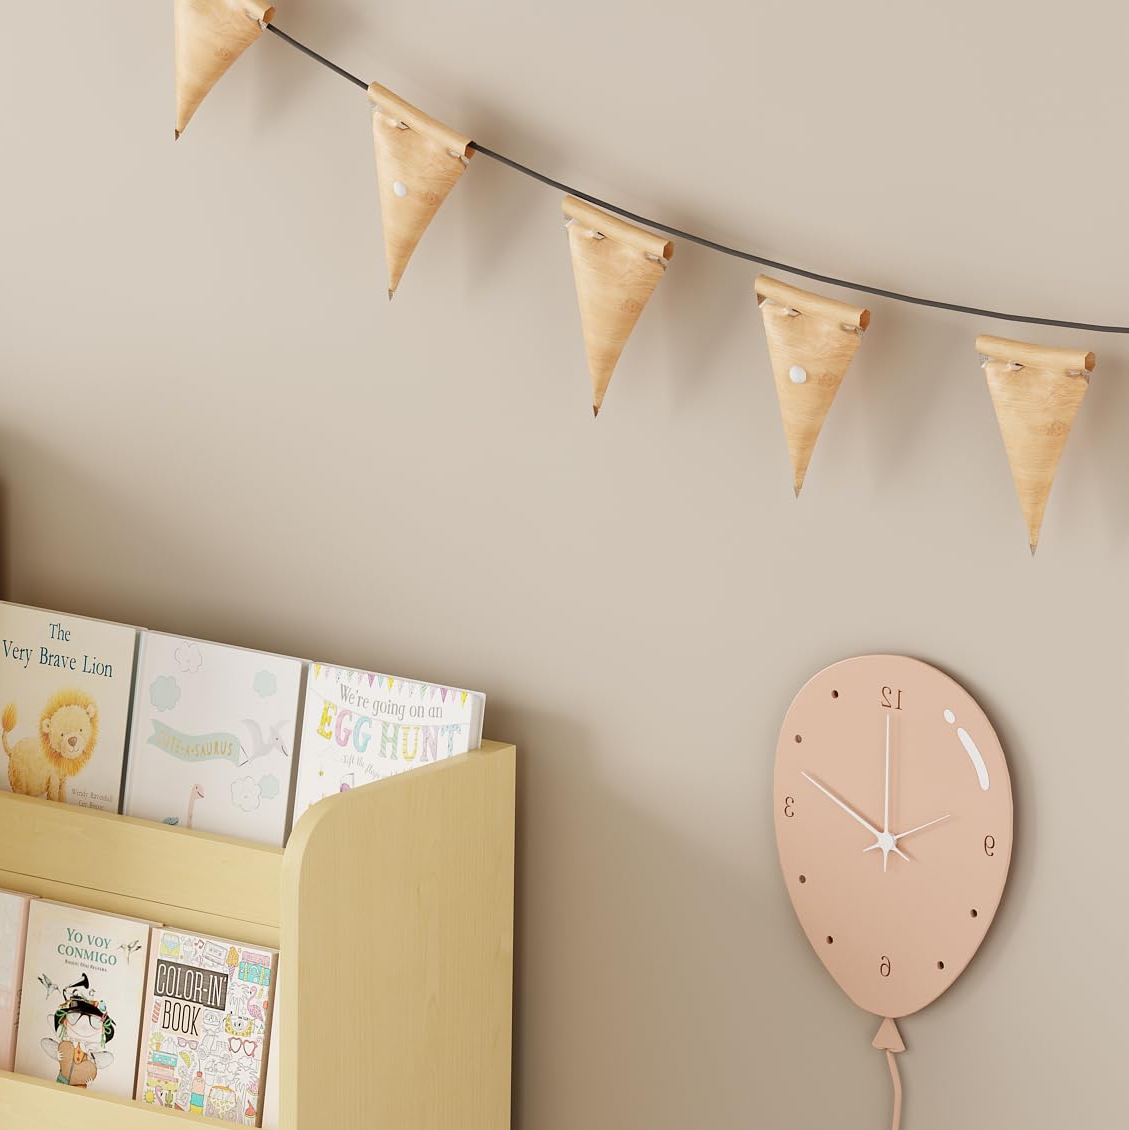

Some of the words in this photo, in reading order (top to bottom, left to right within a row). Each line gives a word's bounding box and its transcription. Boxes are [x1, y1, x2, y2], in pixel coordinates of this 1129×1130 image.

[49, 623, 71, 642] The
[2, 639, 33, 668] Very
[39, 647, 77, 671] Brave
[82, 655, 113, 678] Lion
[340, 683, 370, 709] We're
[372, 699, 405, 721] going
[409, 705, 424, 718] on
[428, 706, 443, 719] an
[316, 699, 373, 753] EGG
[378, 723, 462, 762] HUNT
[57, 944, 117, 966] CONMIGO
[66, 927, 83, 944] YO
[86, 935, 112, 950] VOY
[162, 999, 201, 1036] BOOK
